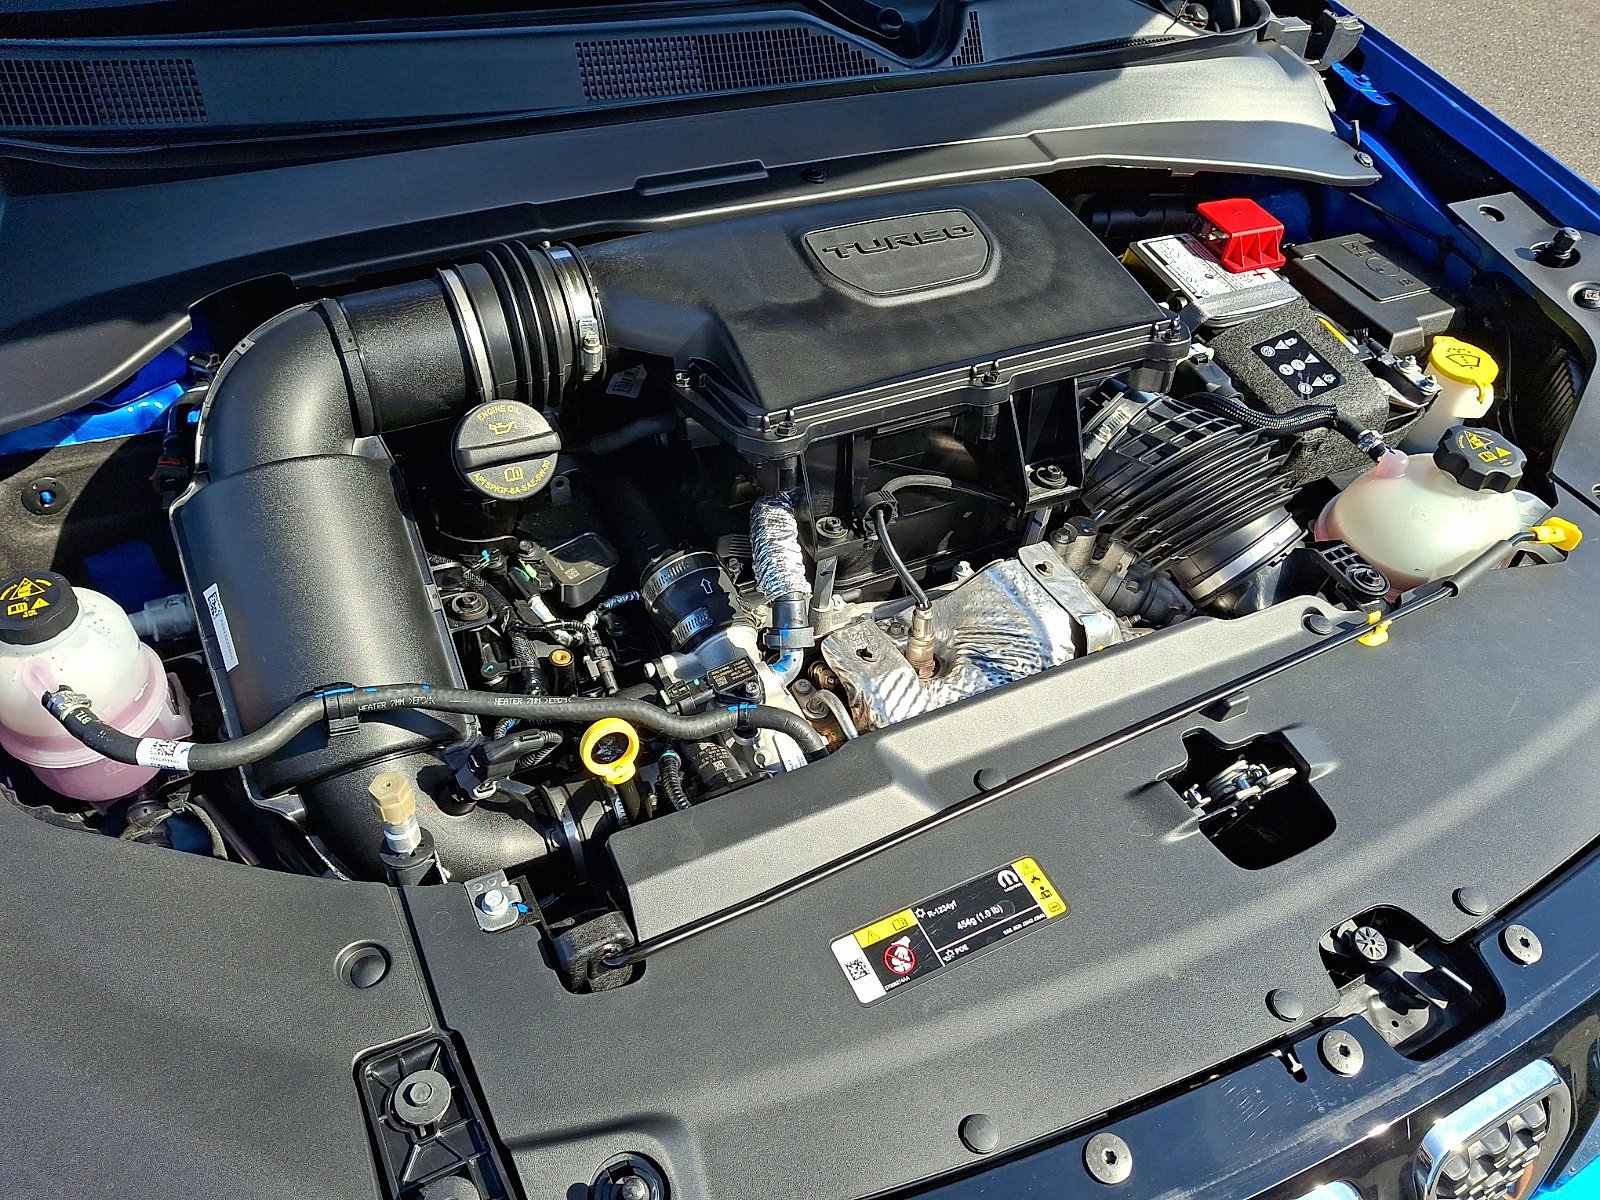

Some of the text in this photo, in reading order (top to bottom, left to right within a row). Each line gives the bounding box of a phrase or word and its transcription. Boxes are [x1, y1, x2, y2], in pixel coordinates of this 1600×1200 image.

[822, 224, 975, 259] TURBO
[476, 405, 521, 421] ENGINE OIL
[358, 701, 387, 712] HEATER
[391, 698, 405, 707] 7MM
[494, 697, 522, 706] HEATER
[926, 900, 958, 919] R-1234yf
[957, 904, 1004, 930] 454g (1.0 lb)
[954, 944, 970, 955] POE
